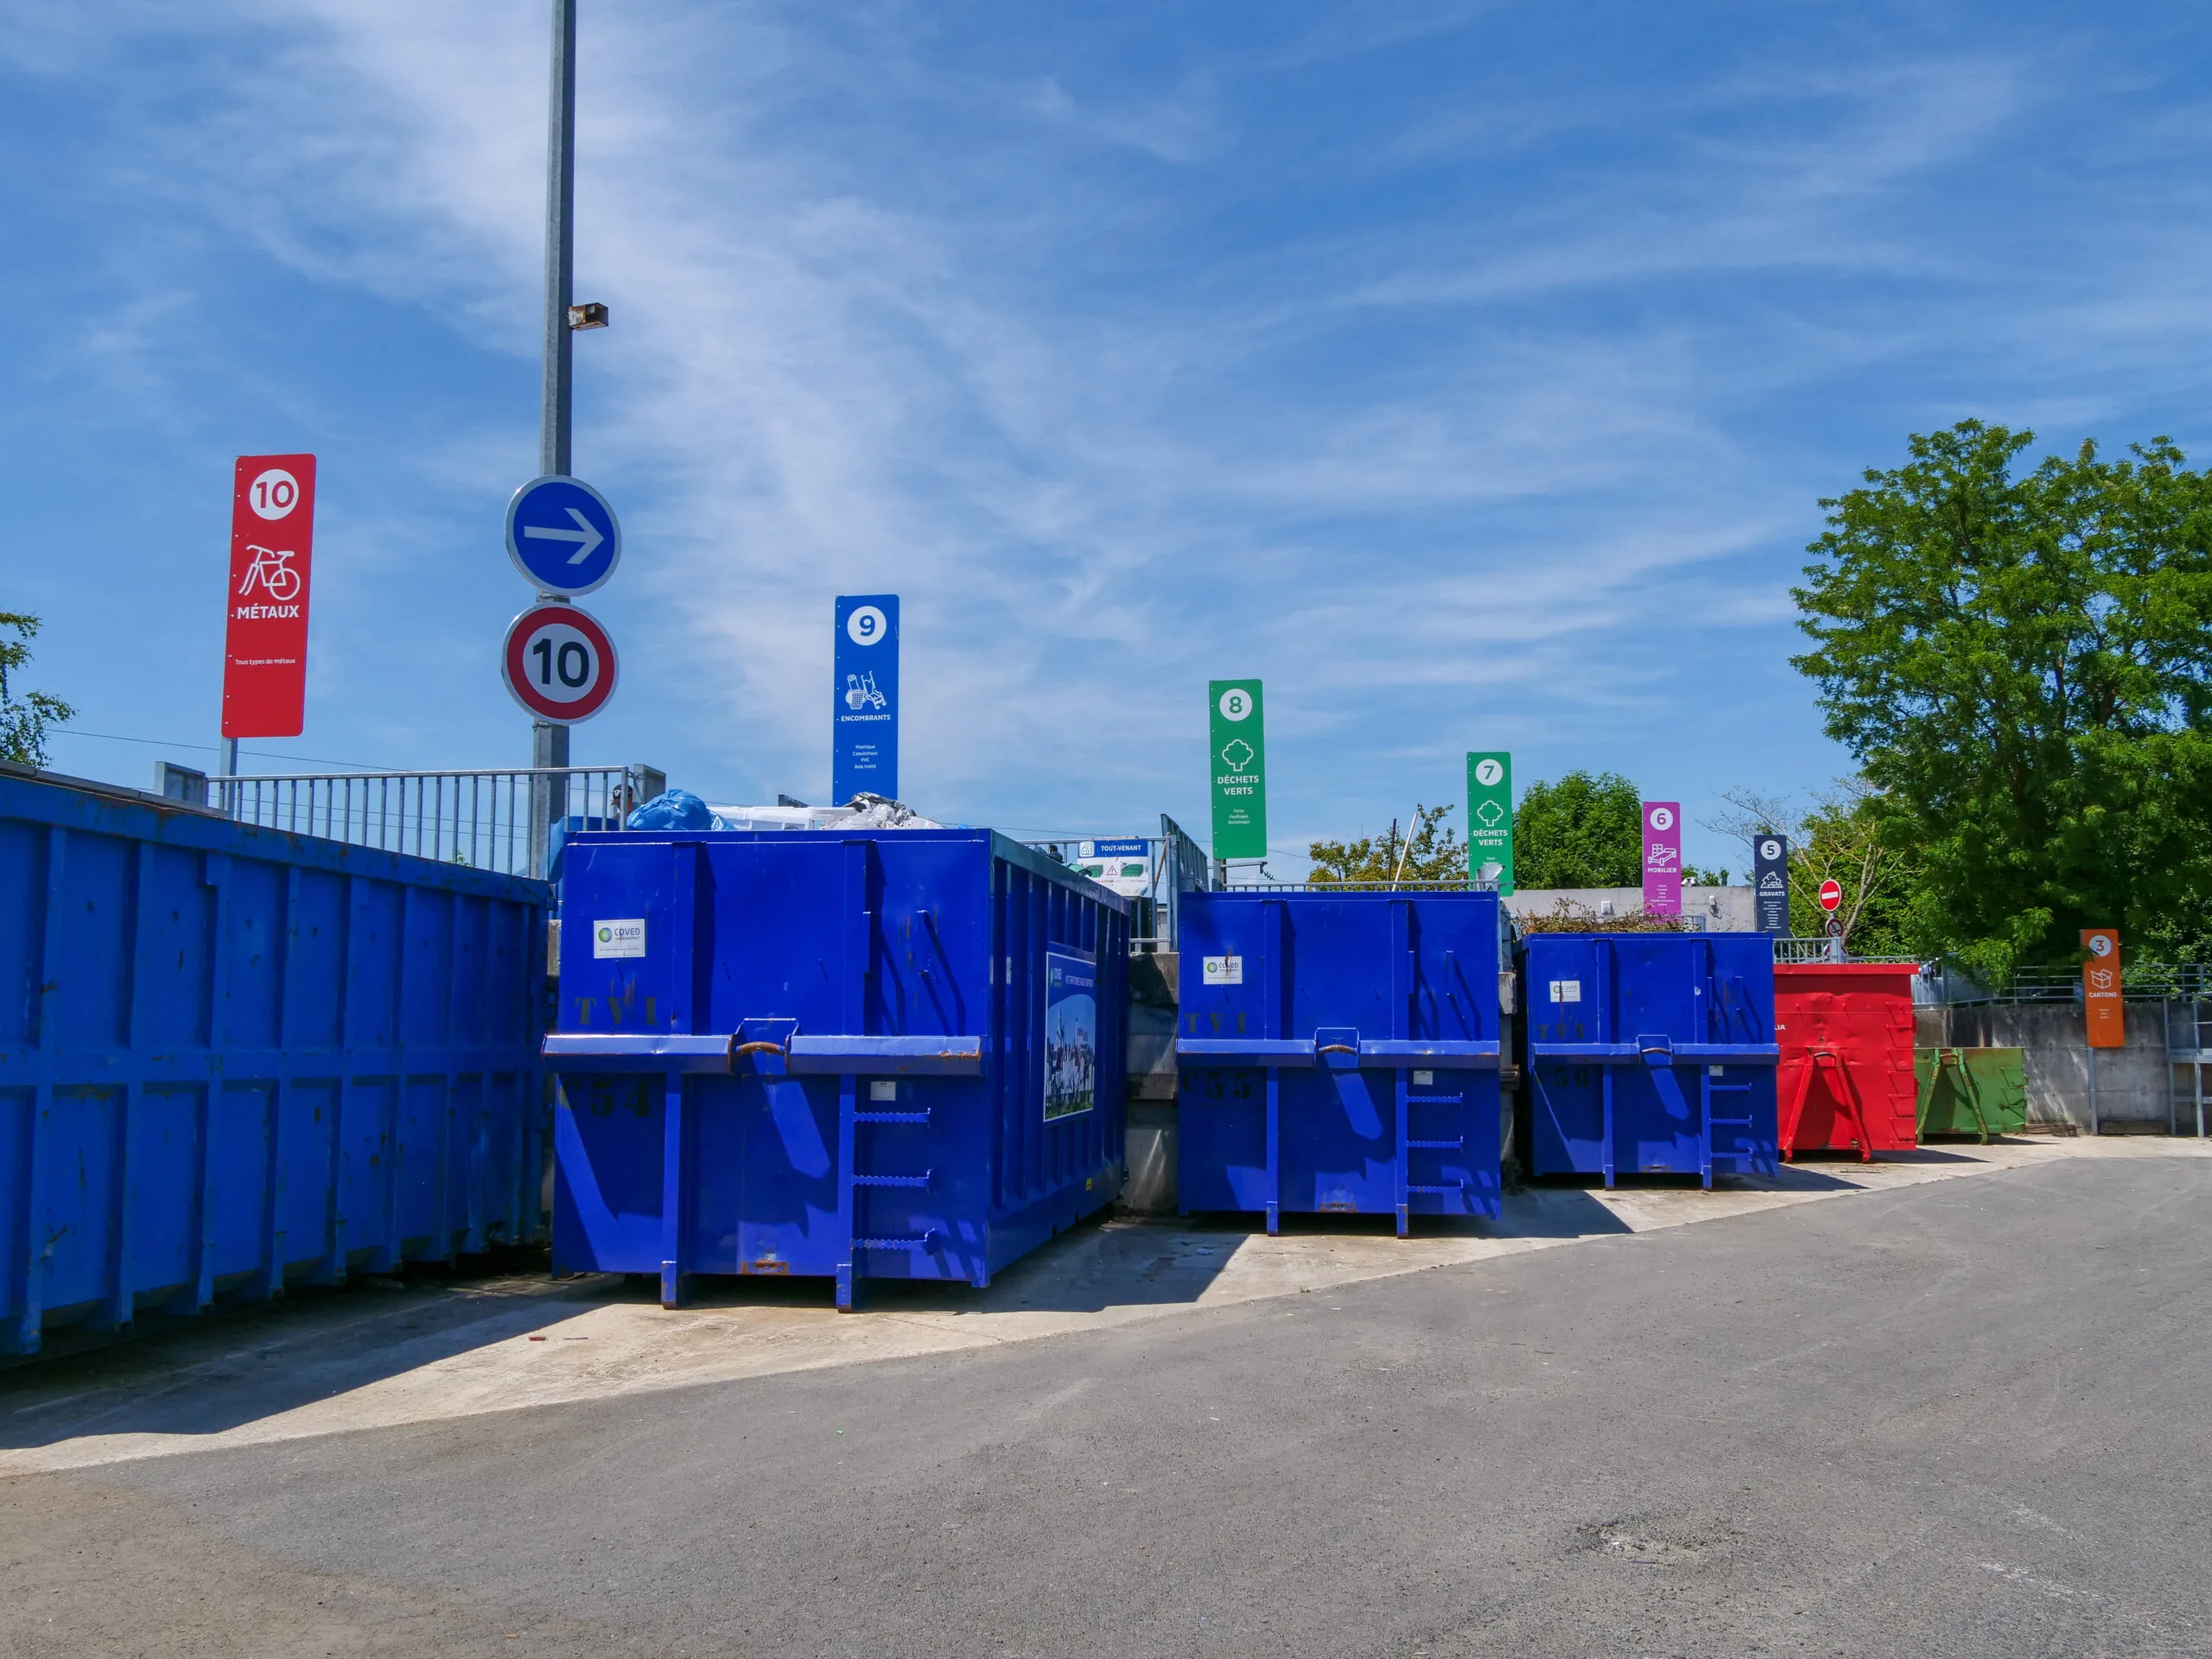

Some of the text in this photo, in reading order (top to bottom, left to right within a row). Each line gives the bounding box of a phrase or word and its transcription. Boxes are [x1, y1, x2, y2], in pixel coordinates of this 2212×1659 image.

[256, 480, 295, 509] 10
[237, 602, 300, 620] MÉTAUX
[859, 614, 876, 637] 9
[532, 638, 590, 688] 10
[1229, 696, 1243, 715] 8
[1484, 765, 1495, 779] 7
[1217, 773, 1259, 785] DÉCHETS
[1656, 812, 1667, 825] 6
[1473, 828, 1508, 836] DÉCHETS
[1767, 844, 1775, 855] 5
[614, 927, 640, 936] COVED
[2095, 939, 2105, 952] 3
